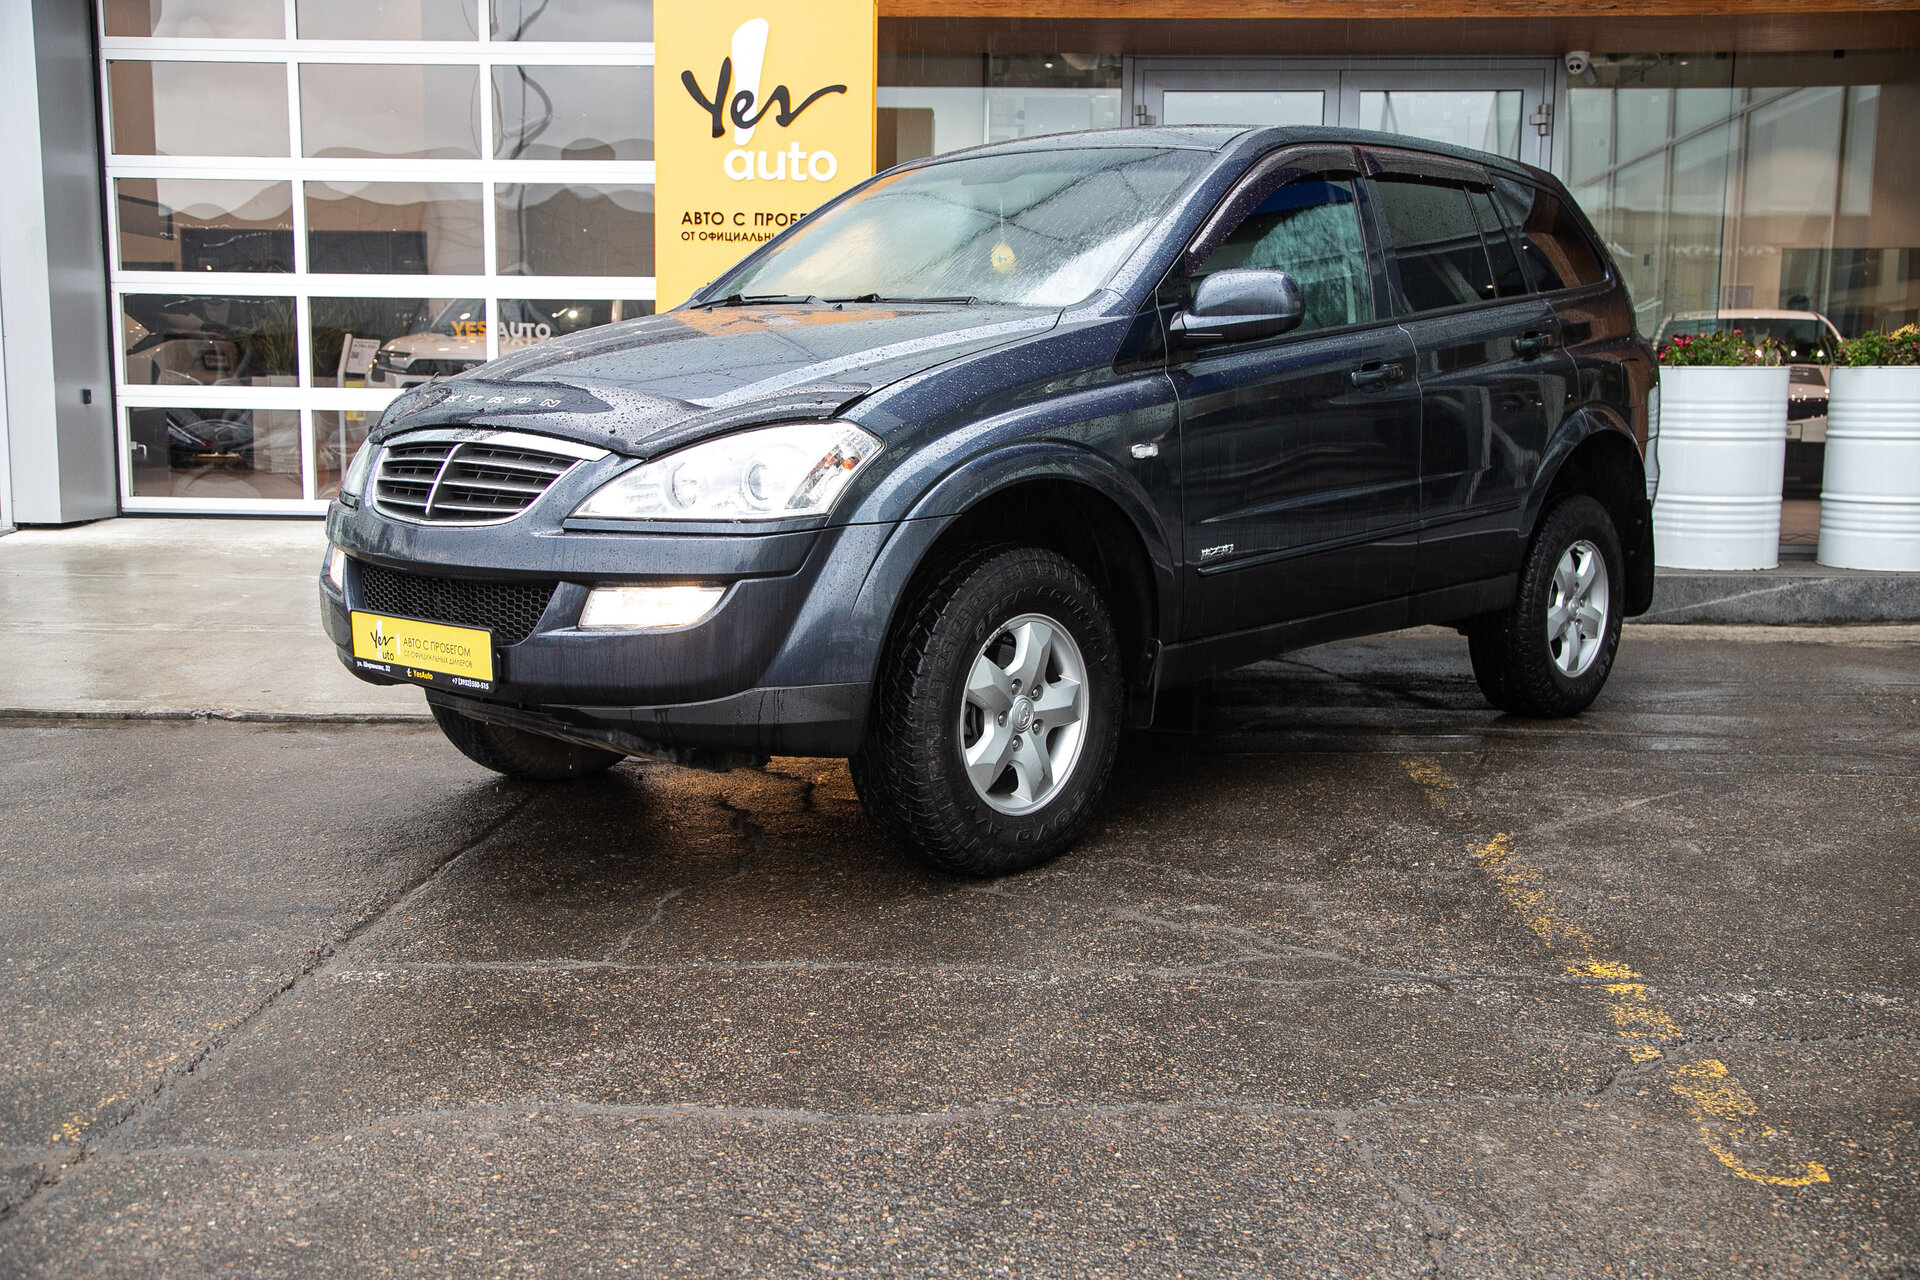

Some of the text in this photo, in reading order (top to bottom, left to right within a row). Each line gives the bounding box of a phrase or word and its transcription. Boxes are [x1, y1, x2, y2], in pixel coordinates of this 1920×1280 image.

[681, 56, 847, 138] Yes
[724, 141, 837, 181] auto
[681, 211, 724, 225] АВТО
[733, 212, 745, 226] С
[681, 231, 695, 241] ОТ
[451, 320, 551, 340] YES AUTO
[443, 395, 561, 408] KYRON
[370, 629, 394, 649] Yes
[403, 637, 472, 657] АВТО С ПРОБЕГОМ
